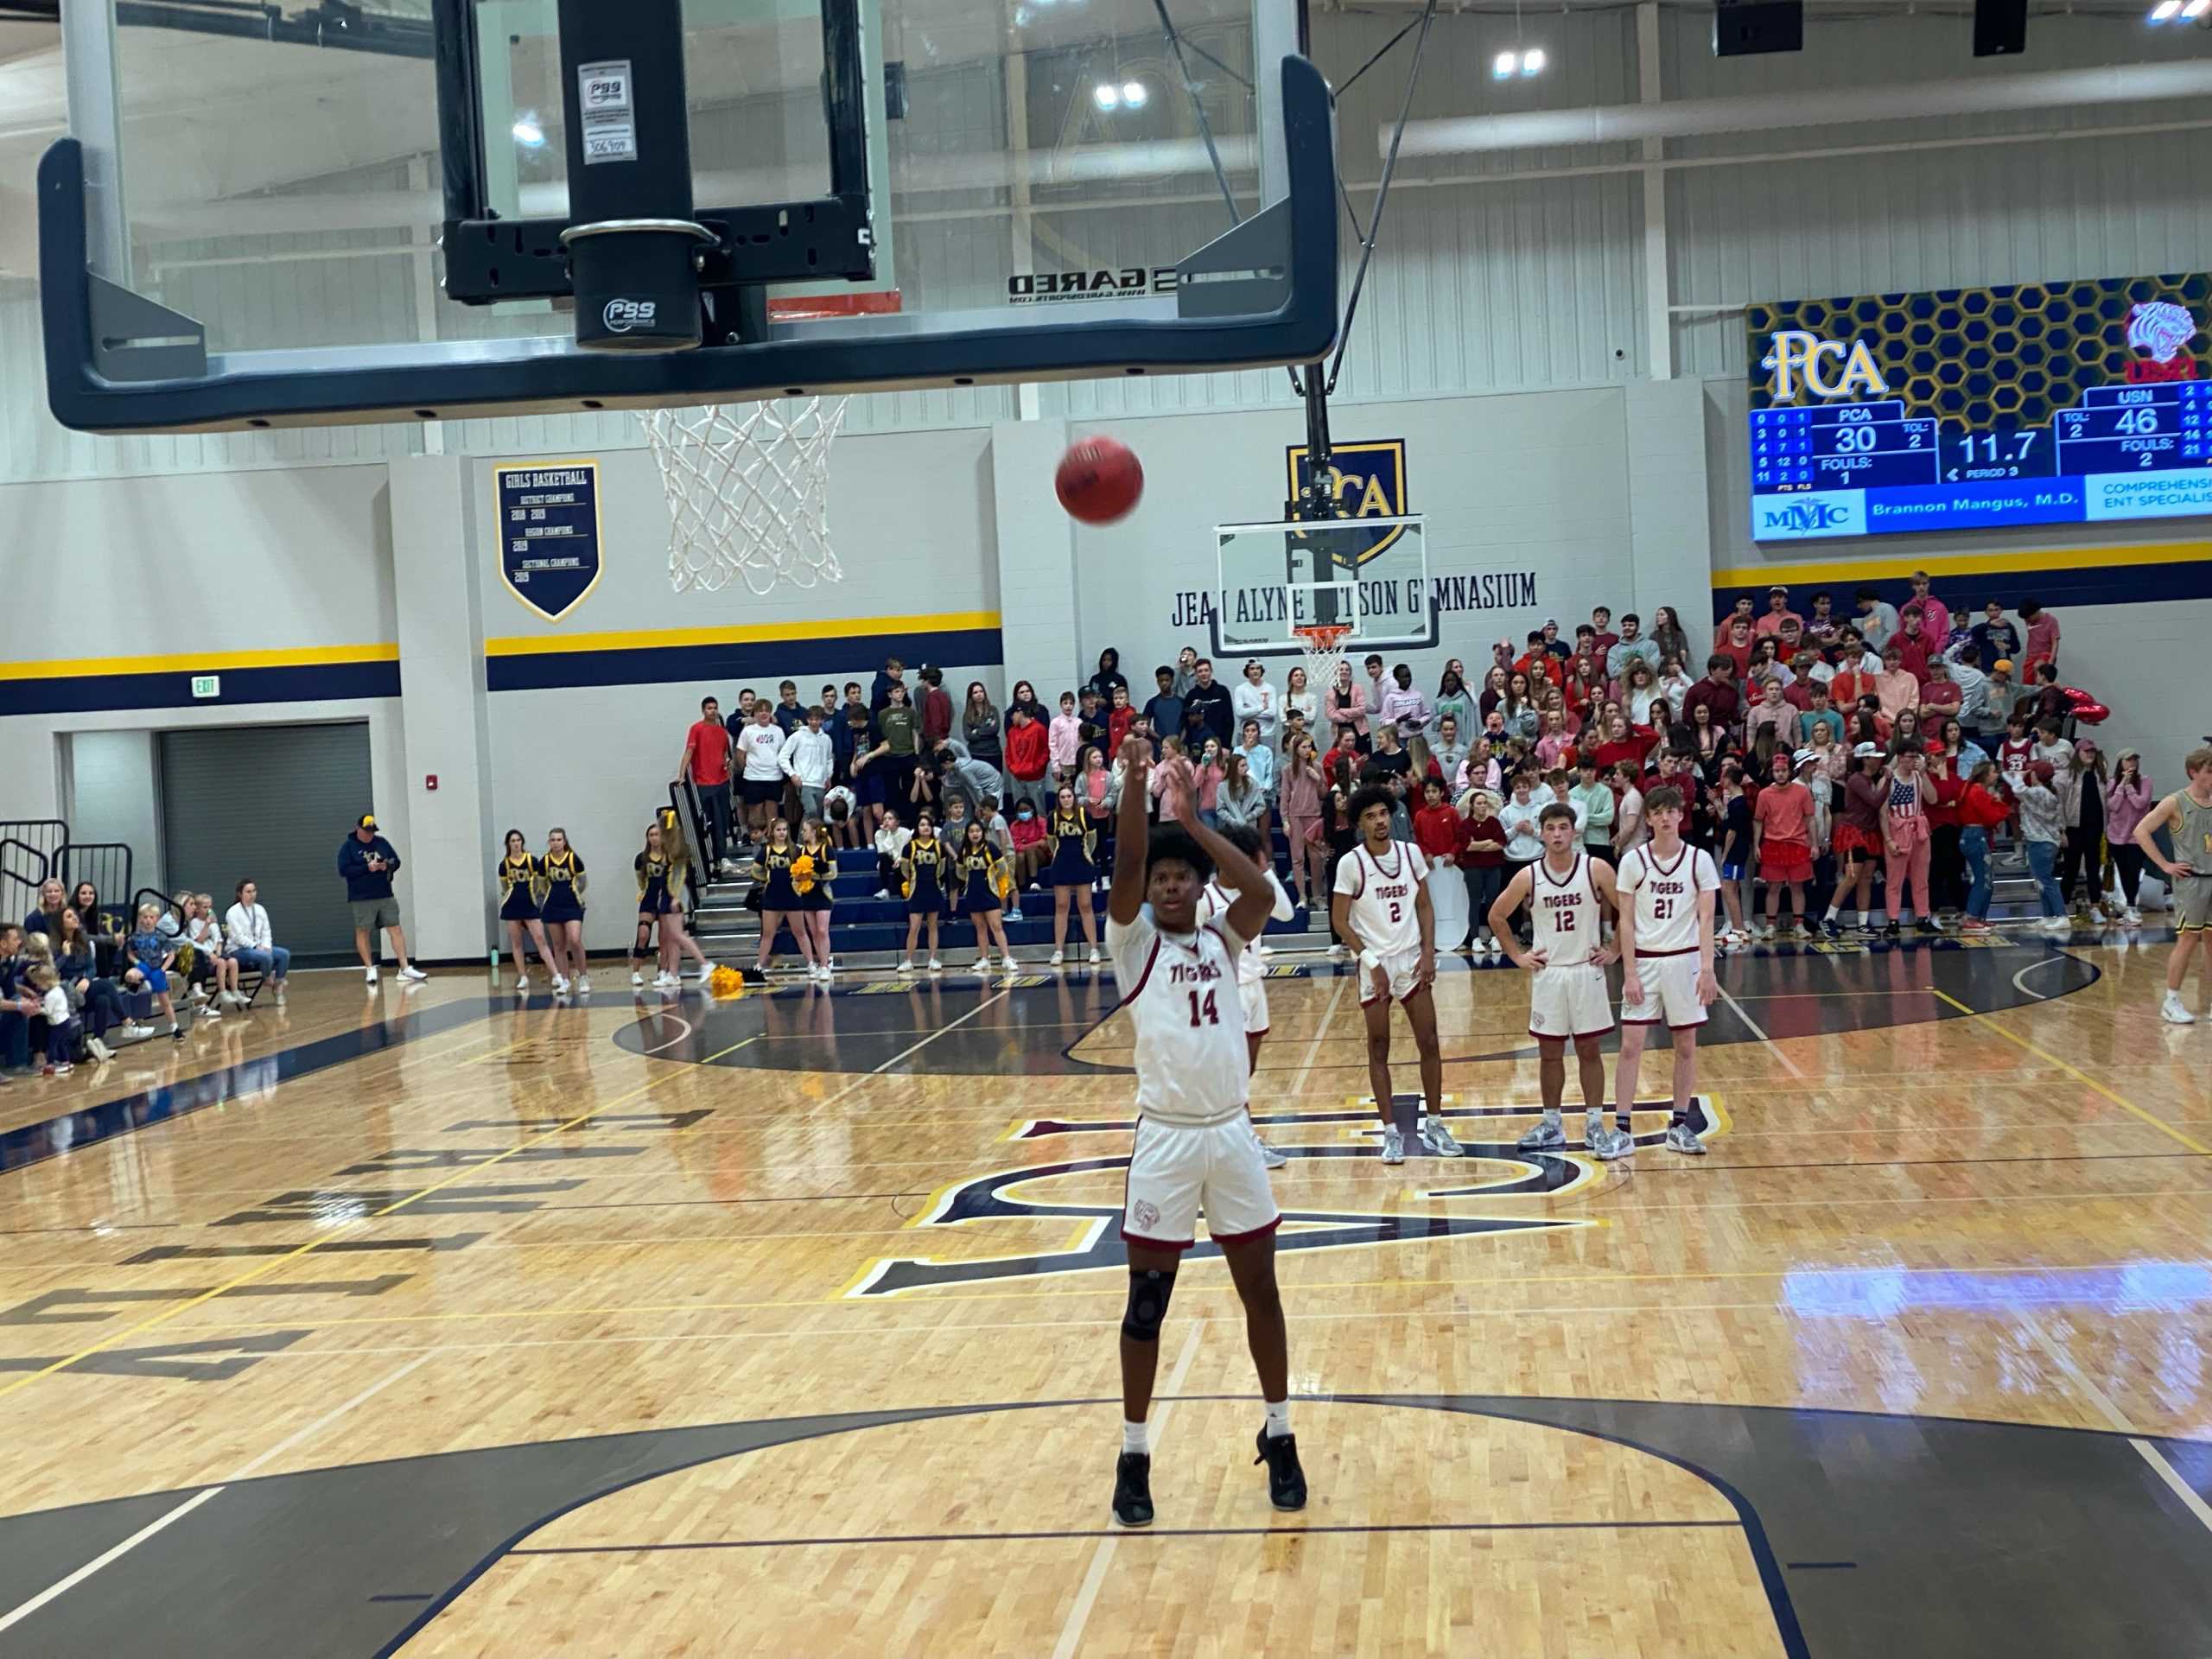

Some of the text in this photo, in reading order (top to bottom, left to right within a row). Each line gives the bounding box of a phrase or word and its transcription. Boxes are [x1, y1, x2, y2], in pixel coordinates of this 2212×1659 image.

[1762, 330, 1890, 400] PCA
[2118, 390, 2153, 404] USN
[2185, 385, 2195, 396] 2
[1839, 409, 1872, 423] PCA
[2114, 408, 2158, 435] 46
[2183, 415, 2199, 426] 12
[1902, 423, 1929, 433] TOL:
[2069, 423, 2082, 438] 2
[1835, 426, 1877, 453] 30
[1909, 434, 1922, 448] 2
[1958, 431, 2037, 463] 11.7
[2121, 438, 2175, 453] FOULS:
[1777, 457, 1790, 467] 12
[1821, 457, 1872, 470] FOULS:
[2139, 452, 2153, 467] 2
[505, 471, 587, 488] GIRLS BASKETBALL
[1757, 471, 1770, 481] 11
[1840, 472, 1850, 485] 1
[1966, 466, 2018, 479] PERIOD 3
[1873, 493, 2078, 515] Brannon Mangus, M.D.
[2105, 496, 2133, 509] ENT
[1236, 587, 1304, 623] ALYNE
[1408, 572, 1537, 613] GMNASIUM
[196, 678, 215, 693] EXIT
[1376, 883, 1408, 899] TIGERS
[1650, 880, 1684, 894] TIGERS
[1543, 893, 1582, 909] TIGERS
[1389, 902, 1401, 923] 2
[1654, 899, 1673, 919] 21
[1554, 911, 1575, 932] 12
[1189, 988, 1219, 1027] 14
